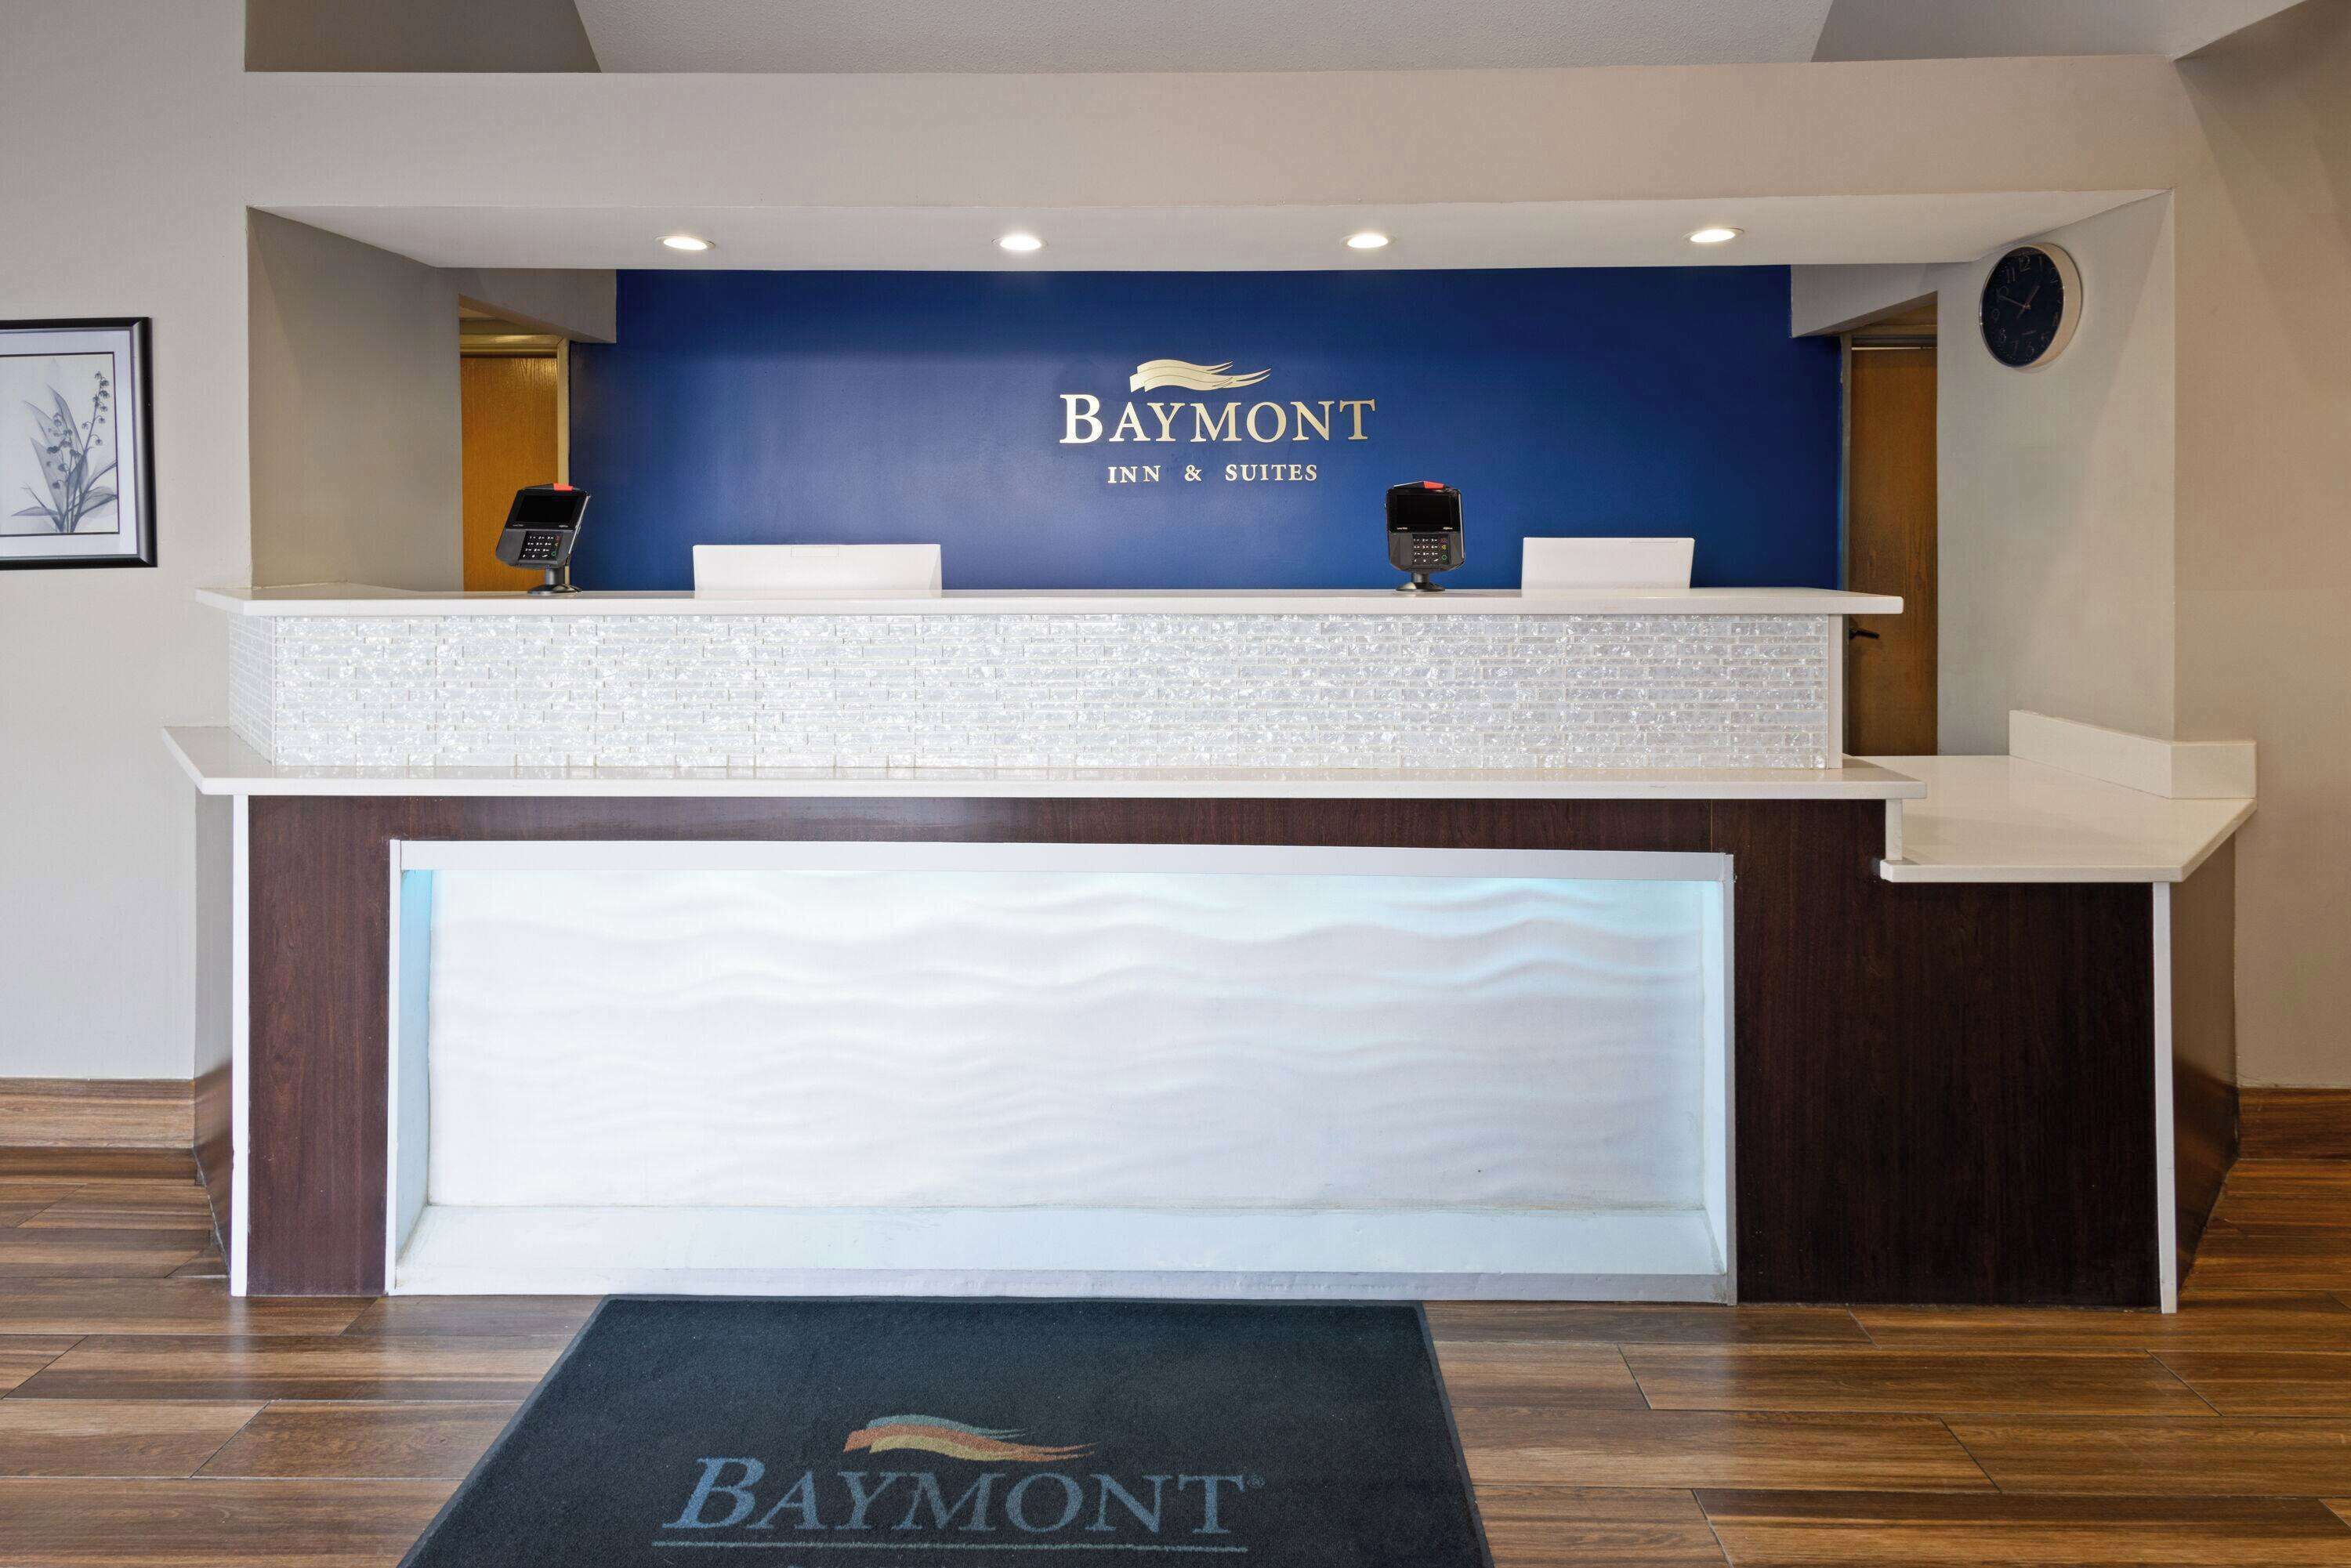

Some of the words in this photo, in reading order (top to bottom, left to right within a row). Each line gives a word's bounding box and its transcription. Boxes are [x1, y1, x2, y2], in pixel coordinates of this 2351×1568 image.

[2018, 255, 2031, 273] 12
[2006, 267, 2016, 284] 11
[2049, 266, 2059, 284] 2
[1991, 308, 2000, 323] 9
[1999, 328, 2008, 343] 8
[1060, 393, 1376, 444] BAYMONT
[1107, 465, 1161, 483] INN
[1184, 464, 1202, 482] &
[1225, 463, 1317, 482] SUITES
